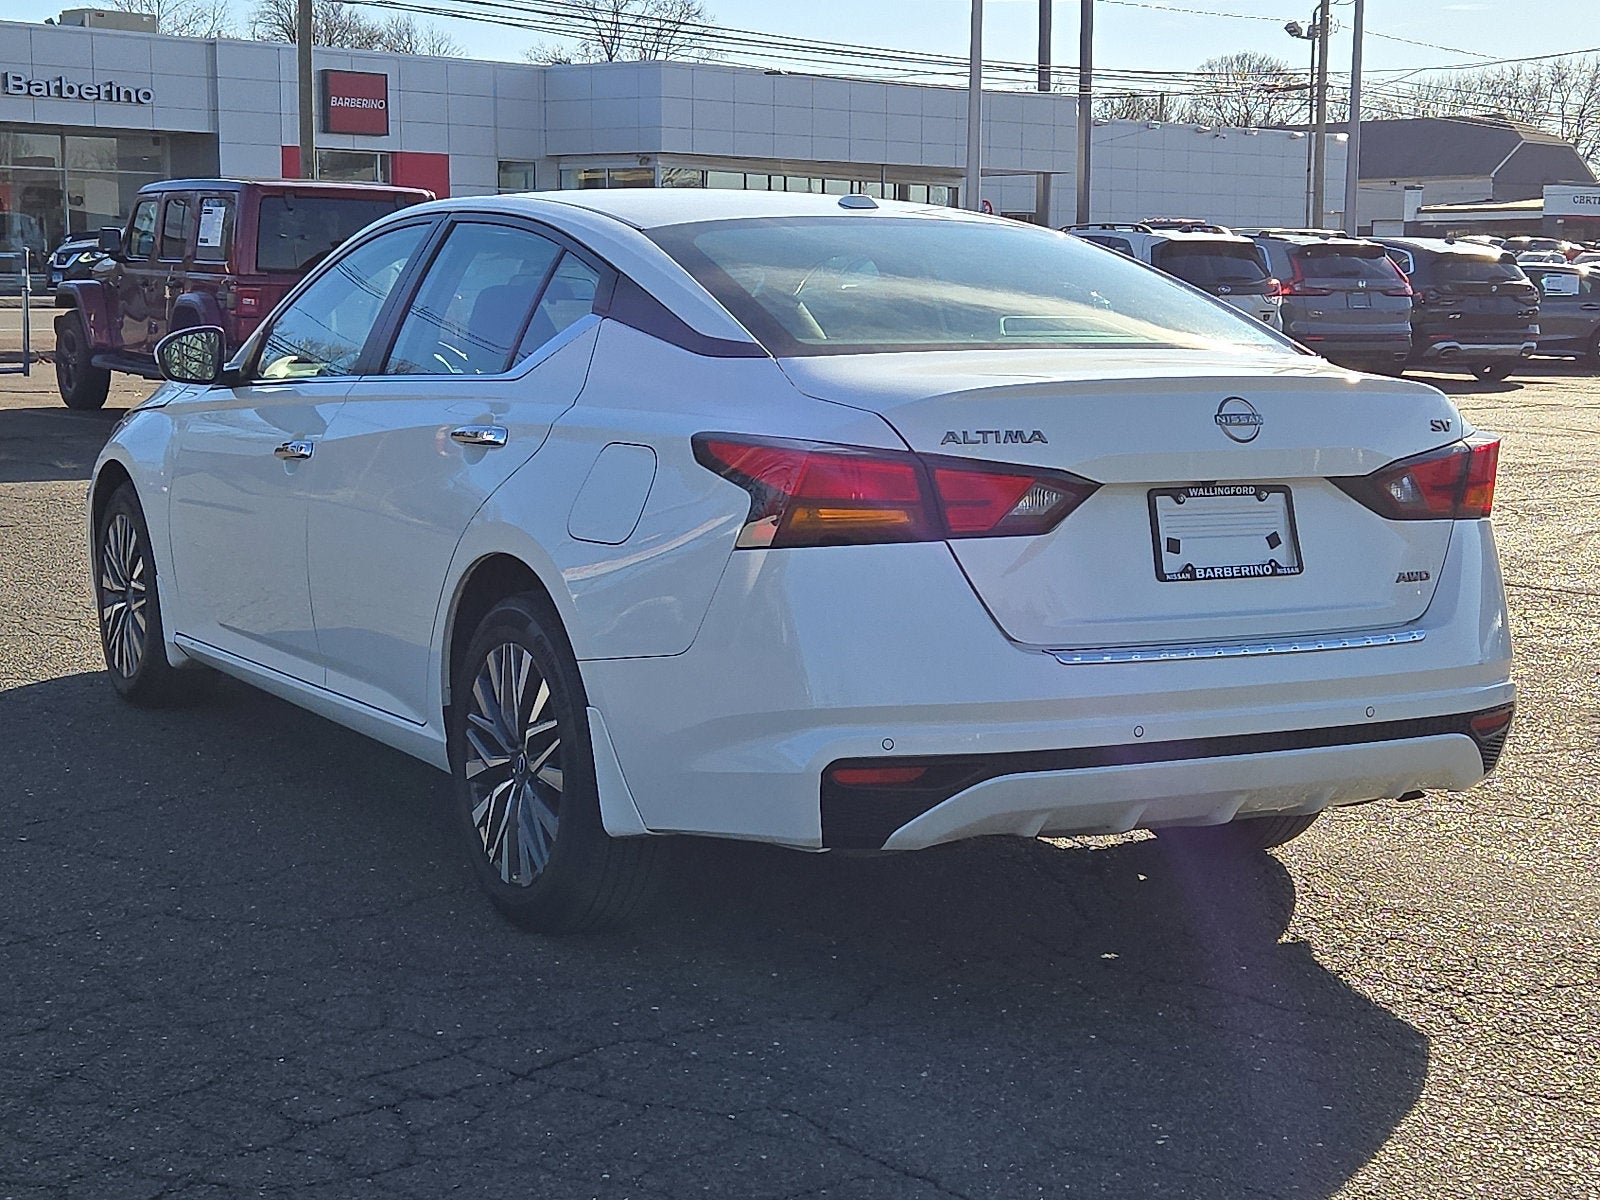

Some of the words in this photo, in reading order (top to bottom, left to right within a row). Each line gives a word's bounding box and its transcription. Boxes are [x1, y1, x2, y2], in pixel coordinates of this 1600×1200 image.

[3, 70, 156, 104] Barberino
[330, 96, 386, 110] BARBERINO
[1216, 414, 1263, 425] NISSAN
[1430, 418, 1452, 432] SV
[940, 429, 1049, 445] ALTIMA
[1188, 486, 1256, 497] WALLINGFORD
[1166, 572, 1191, 581] NISSAN
[1195, 564, 1273, 579] BARBERINO
[1395, 570, 1431, 583] AWD
